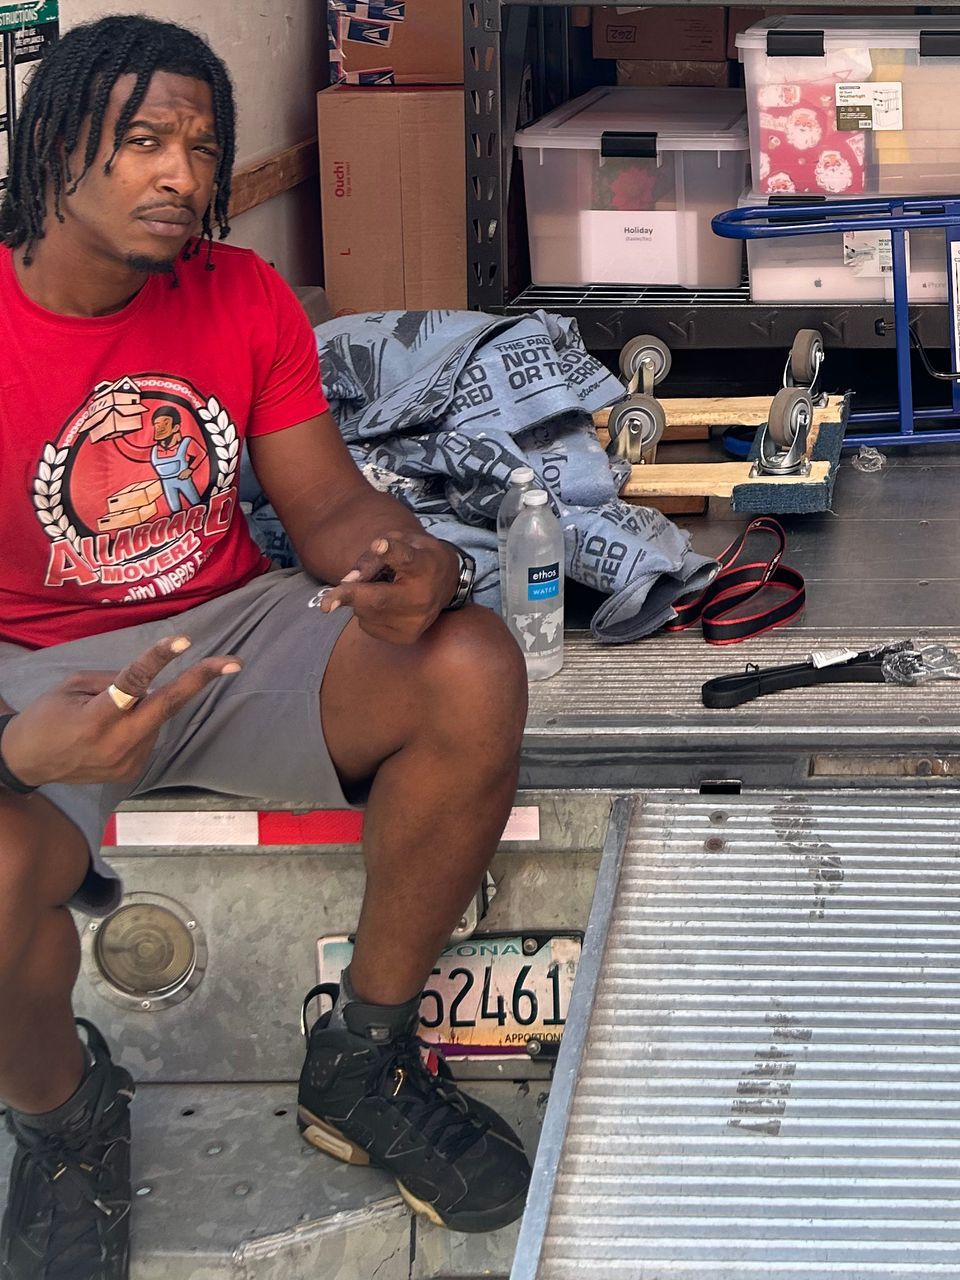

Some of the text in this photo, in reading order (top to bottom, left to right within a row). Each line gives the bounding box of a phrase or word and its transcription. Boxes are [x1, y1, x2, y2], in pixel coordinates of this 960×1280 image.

[333, 161, 345, 197] Ouch!
[624, 227, 653, 236] Holiday
[498, 341, 524, 353] THIS
[502, 347, 551, 372] NOT
[509, 368, 541, 390] OR
[44, 487, 237, 587] ALLABOARD
[100, 531, 201, 584] MOVERZ
[157, 561, 196, 595] Meets
[533, 569, 556, 581] ethos
[441, 943, 520, 957] ZONA
[418, 965, 568, 1027] 52461
[504, 1031, 564, 1044] APPORTION
